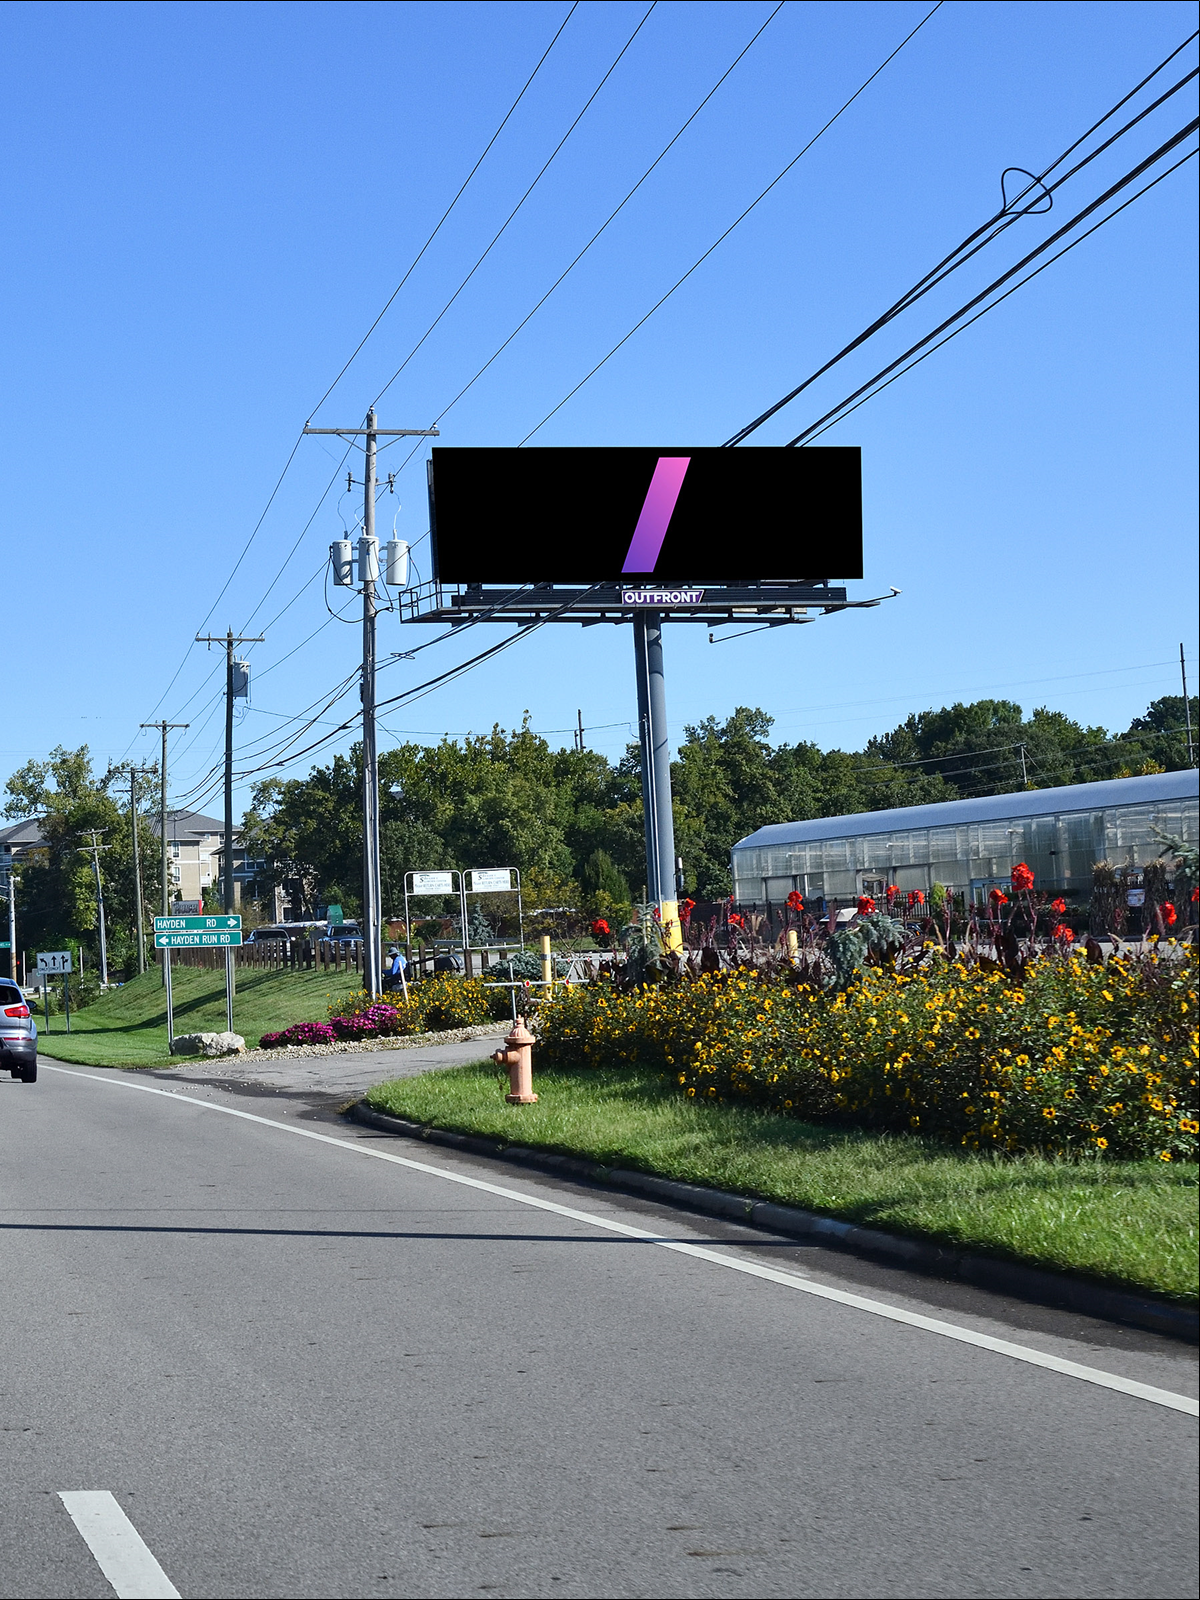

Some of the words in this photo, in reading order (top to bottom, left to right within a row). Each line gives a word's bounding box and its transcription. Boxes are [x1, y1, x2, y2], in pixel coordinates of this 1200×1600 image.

[624, 591, 700, 604] OUTFRONT
[157, 919, 186, 928] HAYDEN
[206, 918, 217, 927] RD
[171, 935, 200, 944] HAYDEN
[202, 935, 217, 944] RUN
[220, 934, 231, 943] RD
